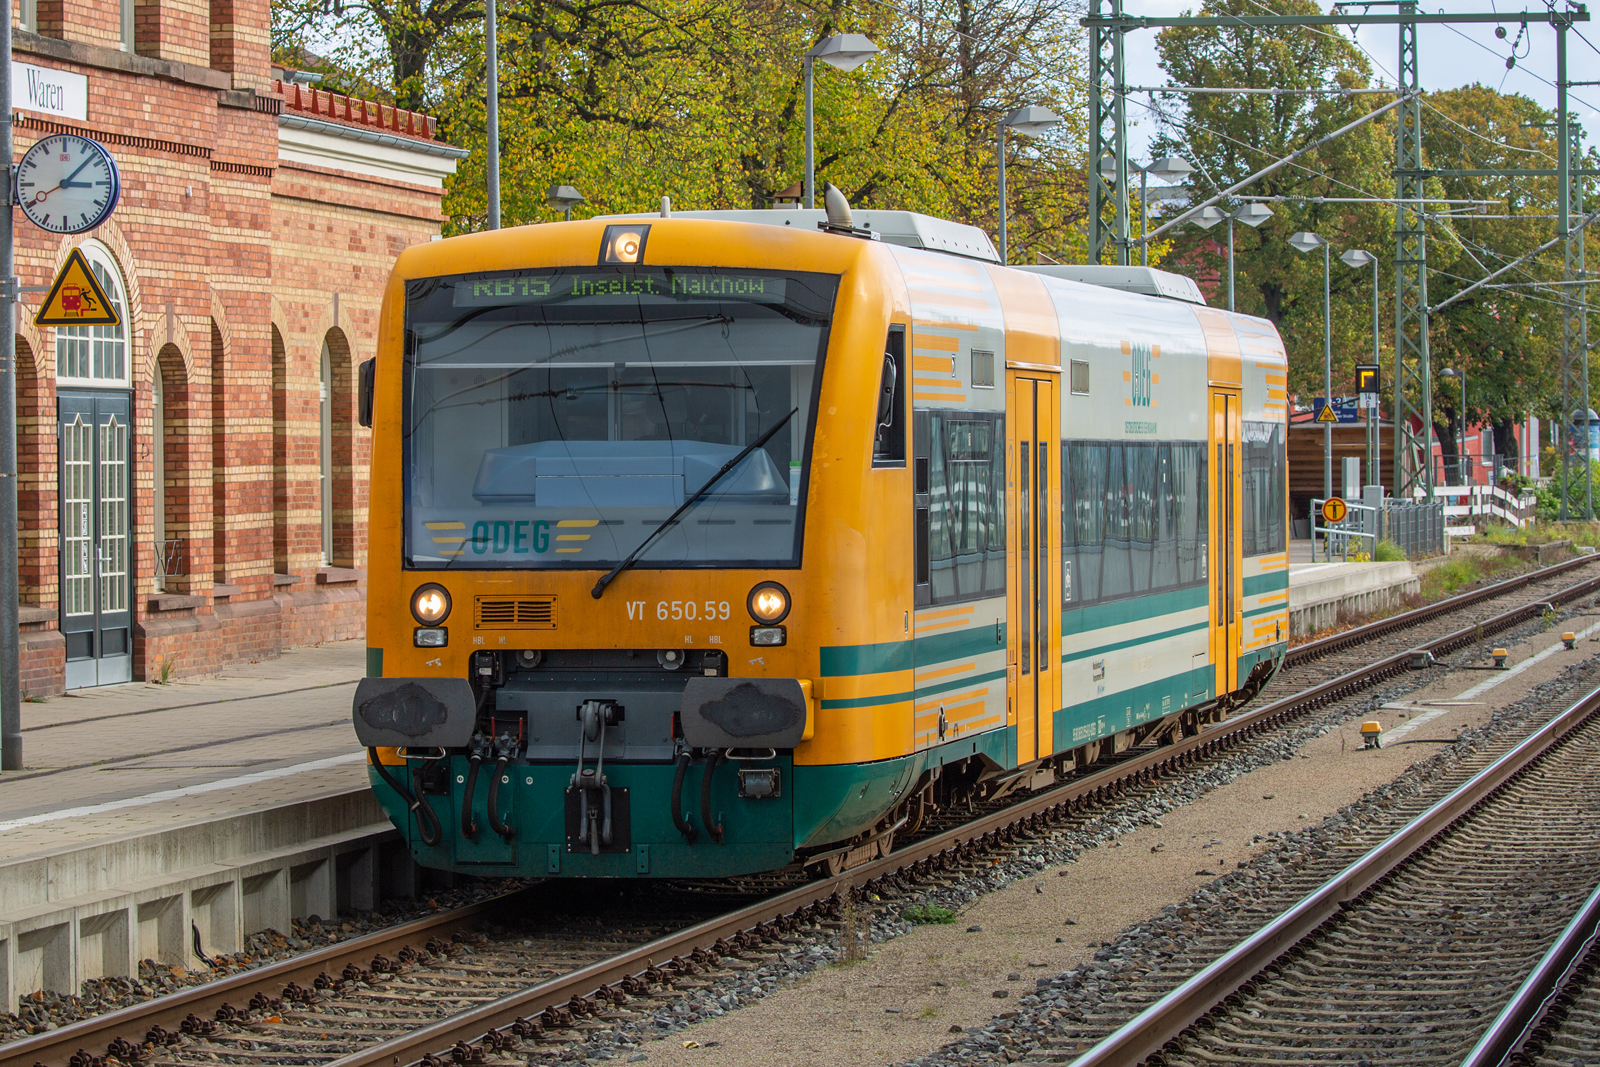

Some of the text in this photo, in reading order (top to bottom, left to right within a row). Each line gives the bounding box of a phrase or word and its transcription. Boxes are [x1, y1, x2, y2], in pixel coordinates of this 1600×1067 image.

[26, 68, 64, 111] Waren
[571, 274, 660, 295] Inselst.
[672, 274, 764, 294] Malchow
[1132, 341, 1151, 407] ODEG
[472, 520, 550, 555] ODEG
[626, 601, 730, 620] VT 650.59
[473, 636, 486, 645] HBL
[684, 635, 723, 644] HL HBL
